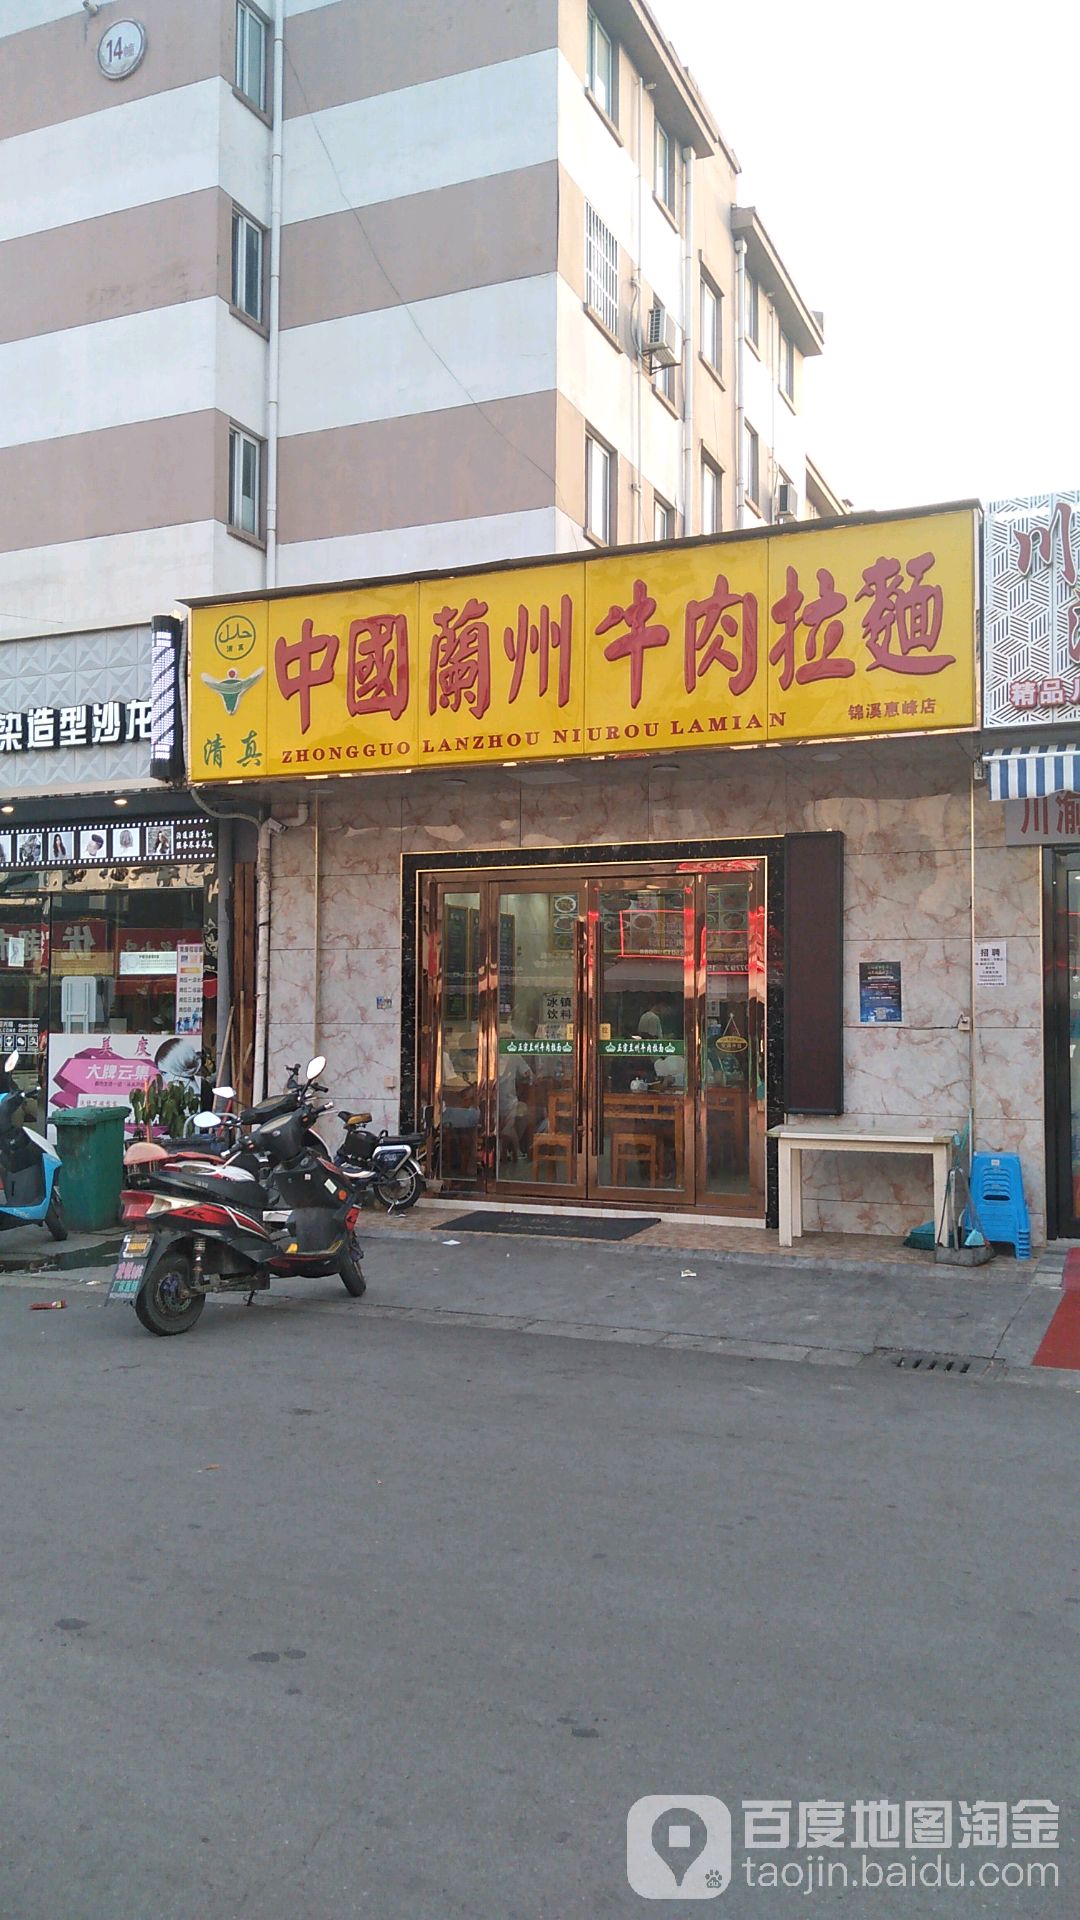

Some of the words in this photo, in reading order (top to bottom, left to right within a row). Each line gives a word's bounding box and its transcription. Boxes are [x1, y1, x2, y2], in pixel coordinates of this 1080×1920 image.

[1010, 676, 1080, 710] 精品
[203, 730, 262, 769] 清真
[281, 740, 411, 763] ZHONGGUO
[422, 731, 540, 754] LANZHOU
[552, 721, 660, 745] NIUROU
[669, 712, 787, 736] LAMIAN
[546, 997, 572, 1008] 冰镇
